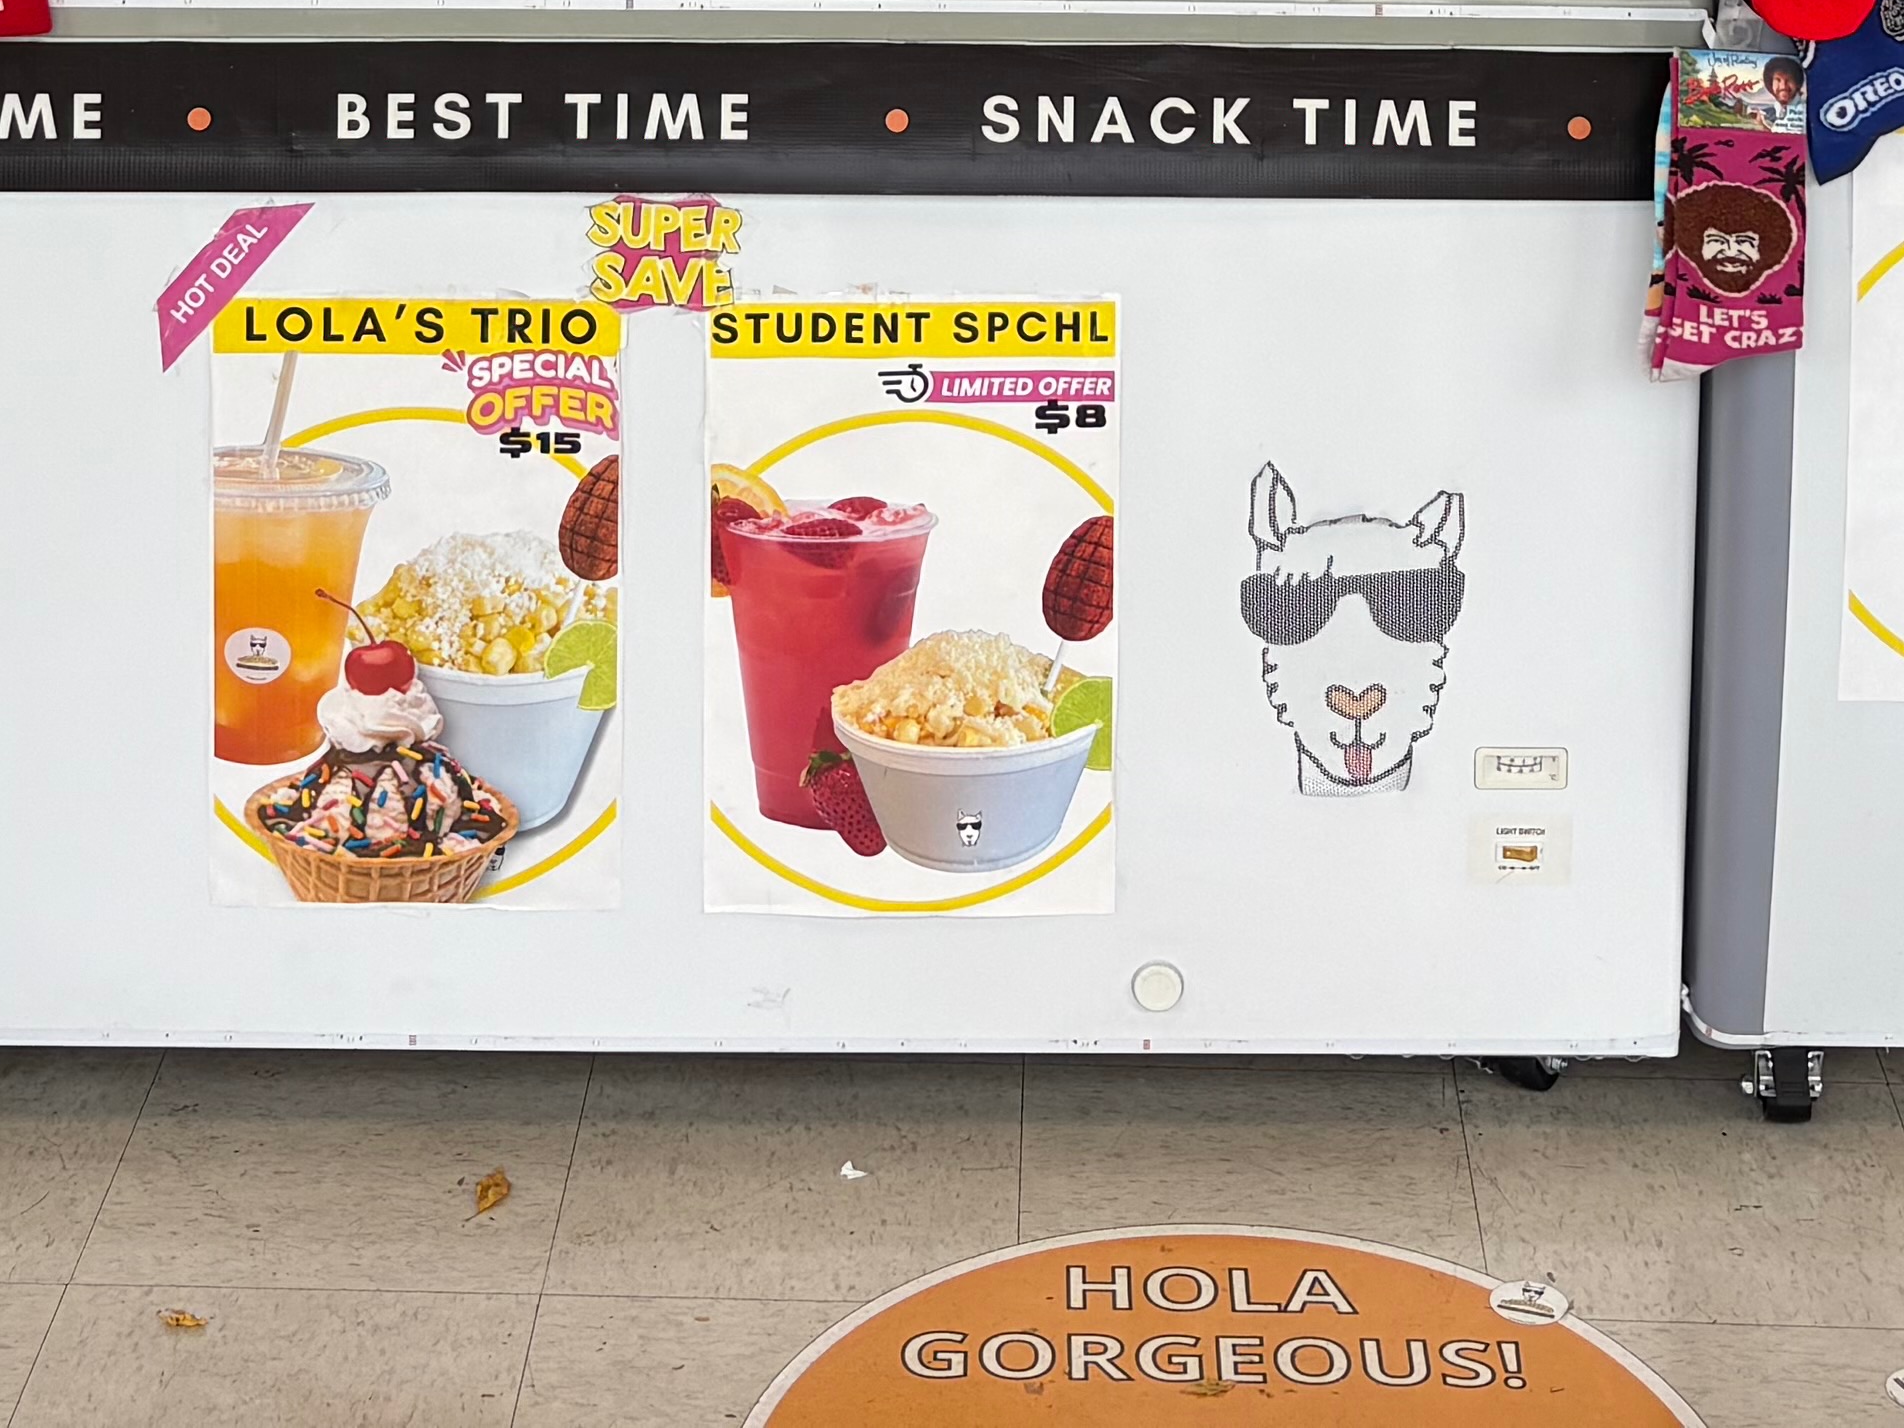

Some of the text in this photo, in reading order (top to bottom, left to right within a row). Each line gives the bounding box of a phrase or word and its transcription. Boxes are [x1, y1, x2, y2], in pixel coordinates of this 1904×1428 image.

[336, 91, 525, 142] BEST
[565, 91, 752, 142] TIME
[980, 94, 1253, 146] SNACK
[1293, 97, 1478, 148] TIME
[586, 198, 743, 255] SUPER
[169, 221, 269, 326] HOT DEAL
[590, 251, 733, 309] SAVE
[245, 303, 598, 345] LOLA'S TRIO
[712, 310, 1110, 346] STUDENT SPCHL
[1699, 304, 1769, 330] LET'S
[471, 351, 613, 391] SPECIAL
[940, 375, 1113, 397] LIMITED OFFER
[469, 383, 615, 430] OFFER
[1034, 398, 1108, 435] $8
[498, 426, 583, 459] $15
[1064, 1264, 1359, 1317] HOLA
[899, 1329, 1531, 1392] GORGEOUS!
